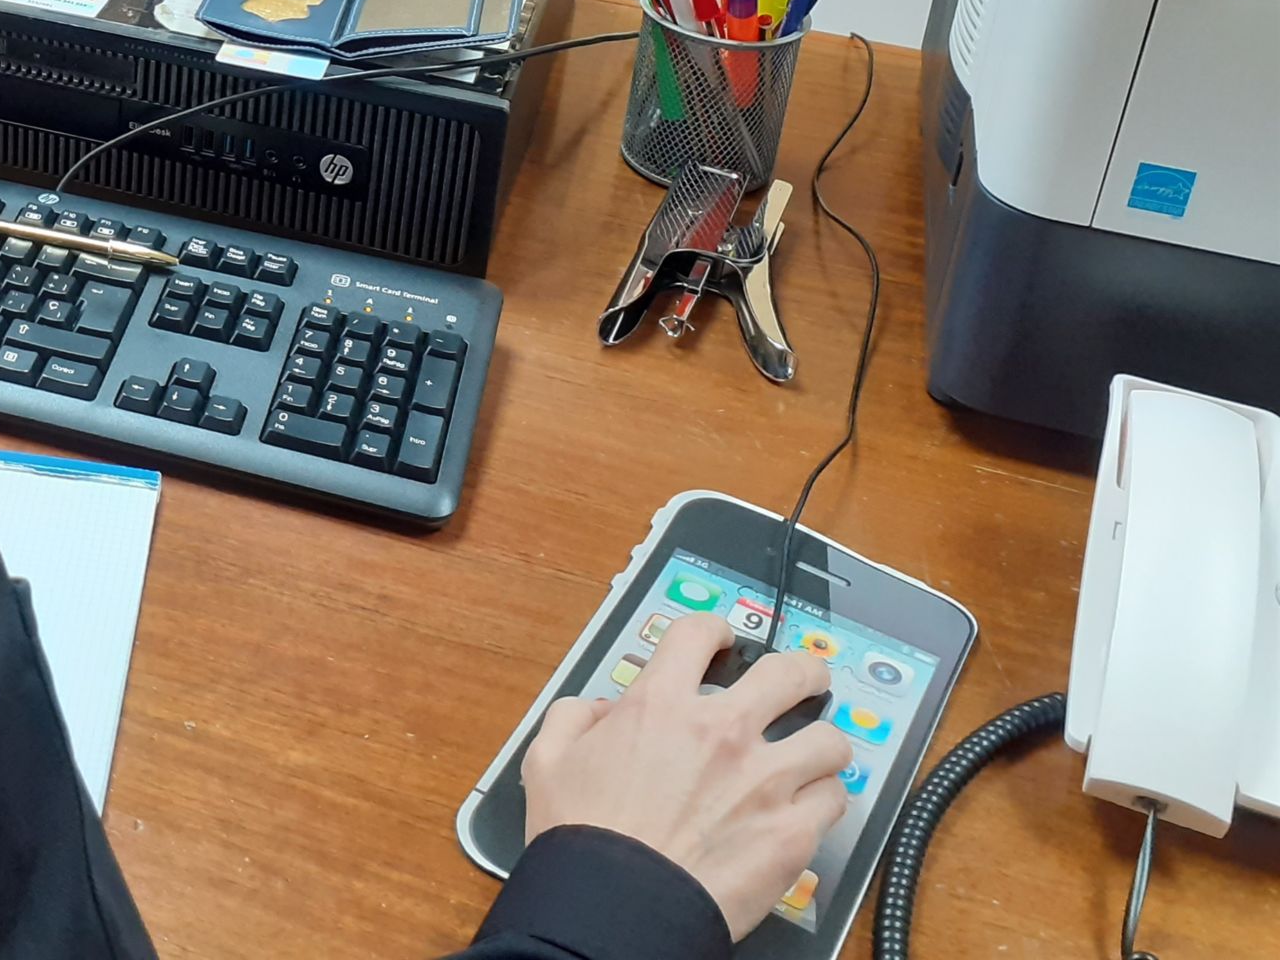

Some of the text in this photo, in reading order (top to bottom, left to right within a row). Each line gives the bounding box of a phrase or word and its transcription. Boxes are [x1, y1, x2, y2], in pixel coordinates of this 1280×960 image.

[129, 121, 171, 137] Eliesk
[319, 152, 355, 187] hp
[175, 279, 194, 287] Insert
[213, 287, 231, 296] Inicio
[355, 281, 439, 305] Smart Card Terminal
[164, 303, 179, 311] Supr
[204, 311, 215, 319] Fin
[304, 330, 314, 338] 7
[343, 339, 353, 348] 8
[386, 348, 397, 358] 9
[295, 357, 304, 366] 4
[51, 363, 75, 375] Control
[335, 366, 346, 376] 5
[377, 376, 388, 386] 6
[282, 393, 294, 402] Fin
[327, 393, 338, 403] 2
[370, 404, 380, 414] 3
[278, 413, 289, 422] 0
[409, 435, 426, 446] Intro
[804, 605, 824, 618] AM
[742, 611, 764, 630] 9
